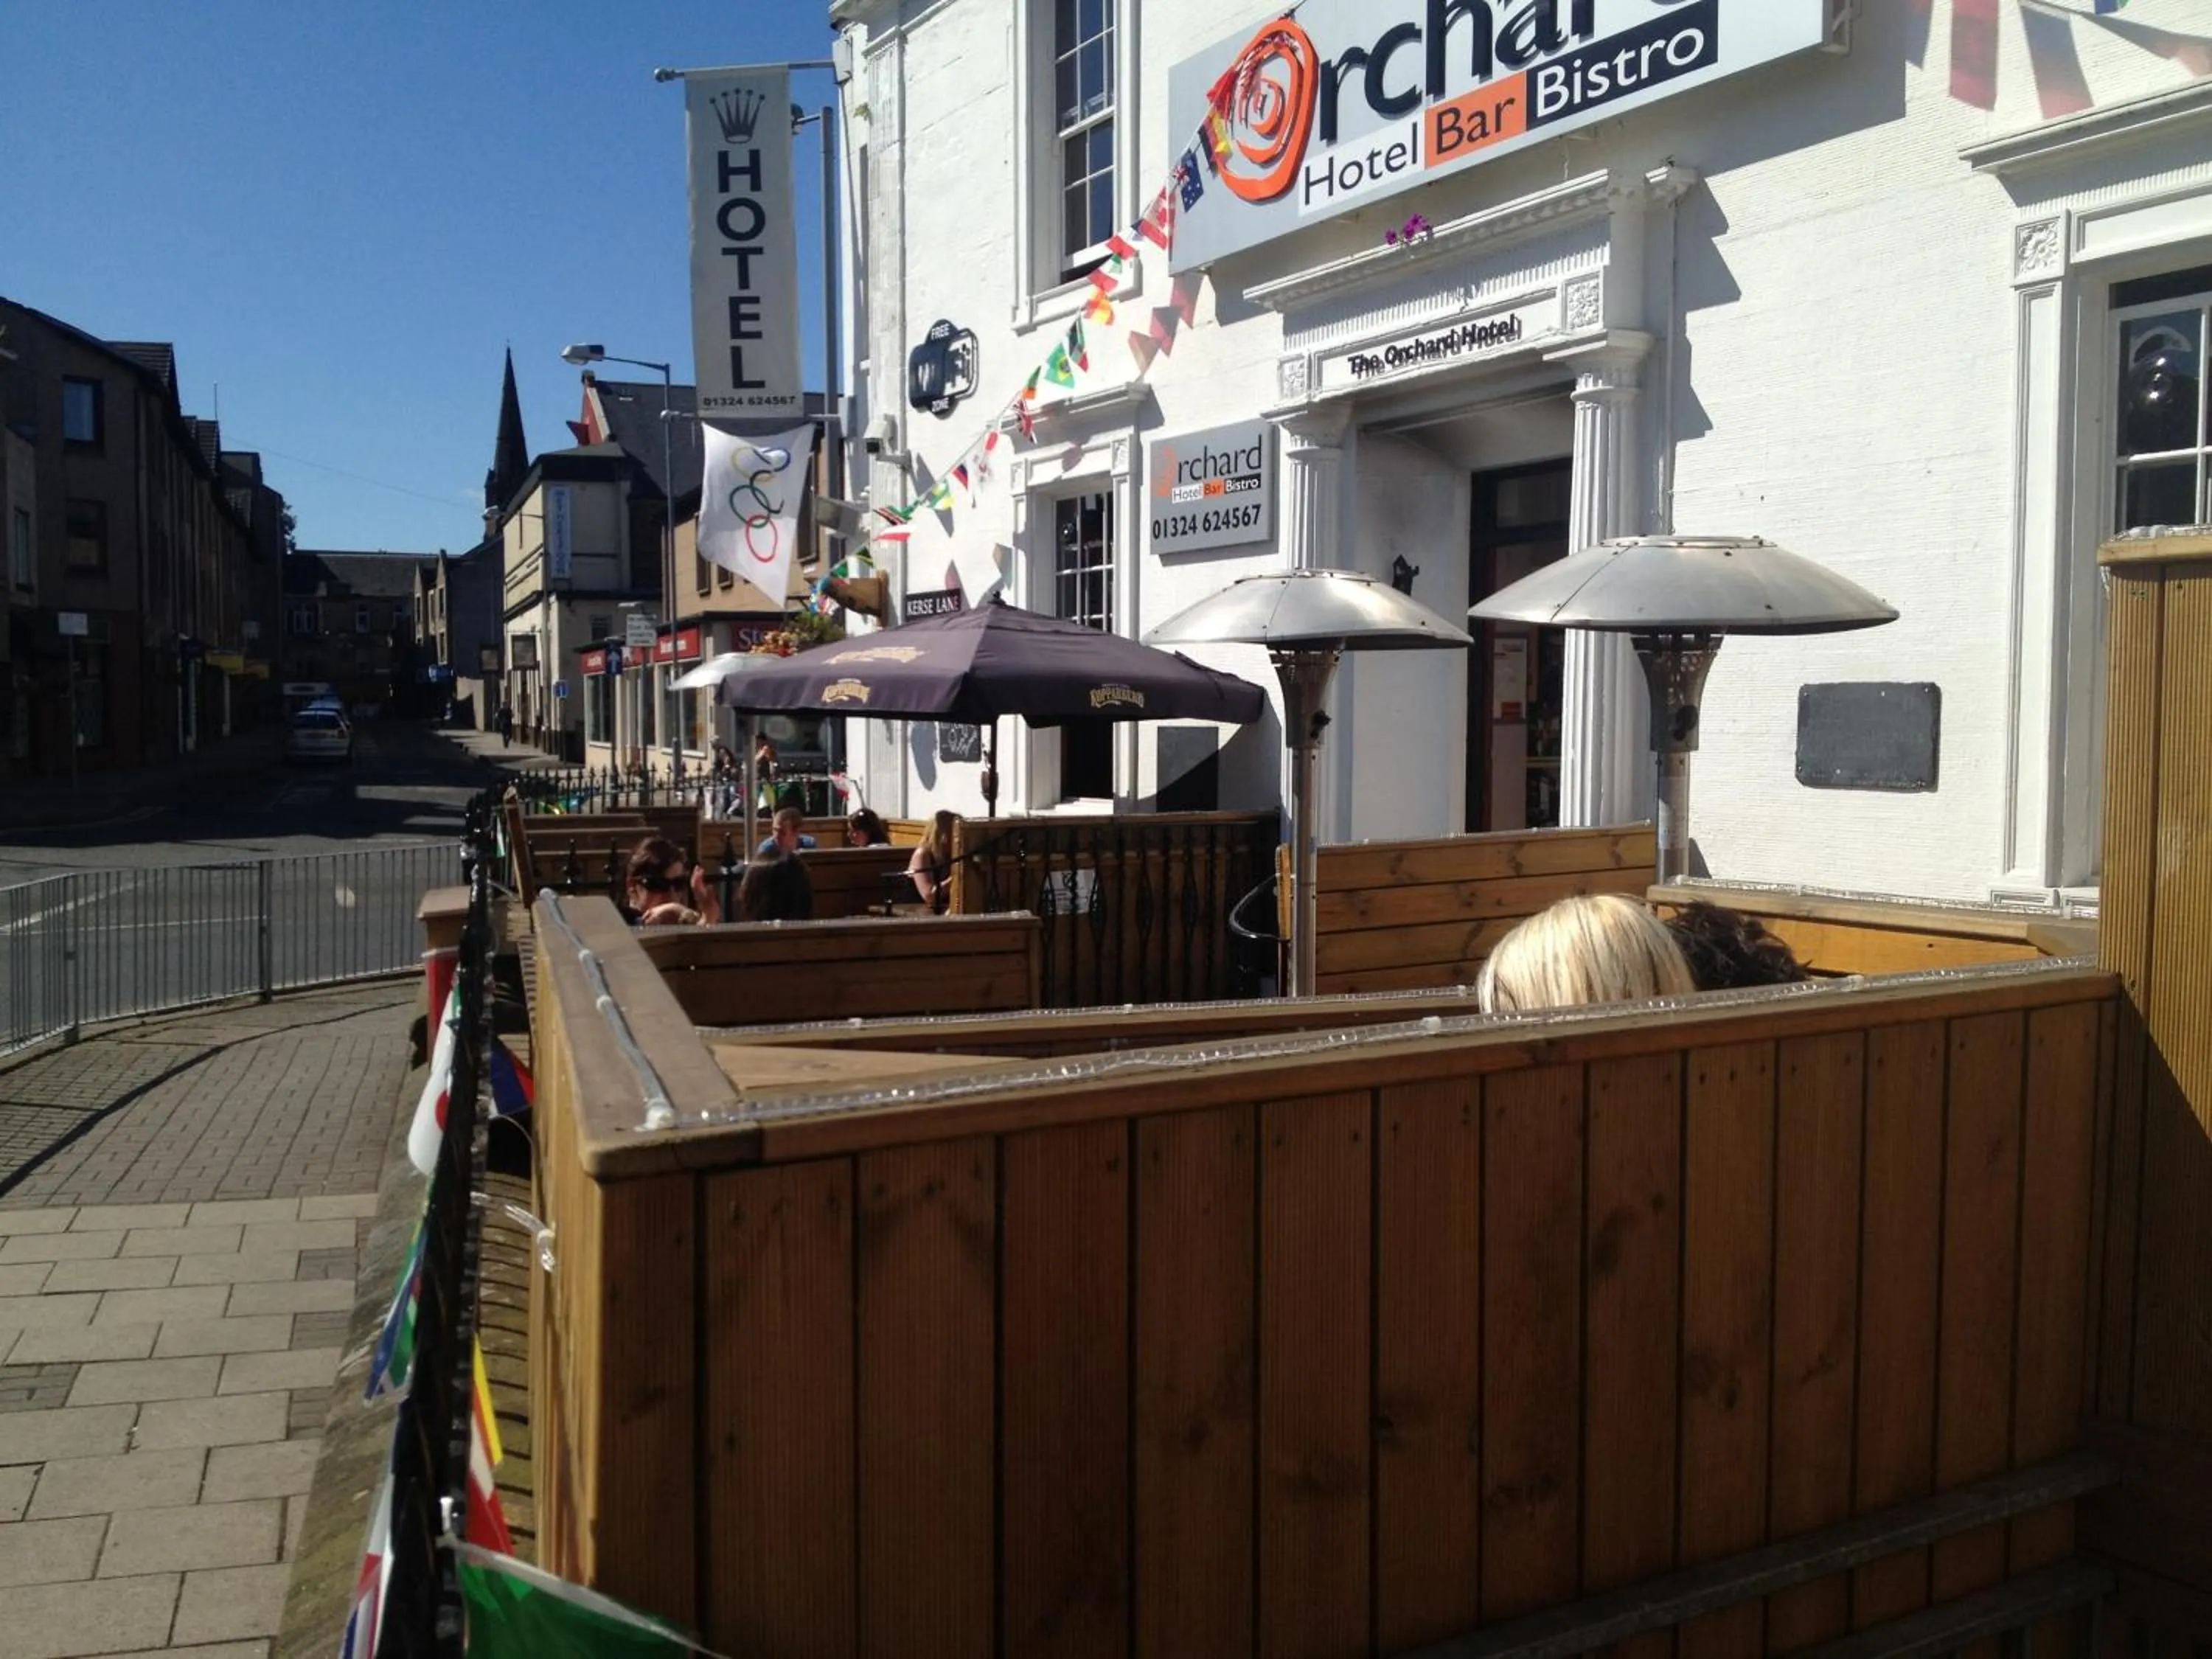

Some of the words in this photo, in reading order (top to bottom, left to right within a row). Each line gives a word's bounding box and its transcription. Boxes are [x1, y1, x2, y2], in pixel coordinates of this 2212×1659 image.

[1304, 121, 1419, 206] Hotel
[1436, 95, 1516, 156] Bar
[1537, 28, 1705, 118] Bistro
[716, 149, 766, 390] HOTEL
[931, 323, 950, 339] FREE
[1347, 353, 1380, 375] The
[1384, 328, 1455, 364] Orchard
[1461, 313, 1516, 346] Hotel
[1172, 484, 1203, 502] Hotel
[1203, 482, 1222, 496] Bar
[1225, 478, 1259, 493] Bistro
[1152, 512, 1198, 540] 01324
[1202, 504, 1262, 533] 624567
[906, 598, 933, 616] KERSE
[936, 594, 959, 613] LANE
